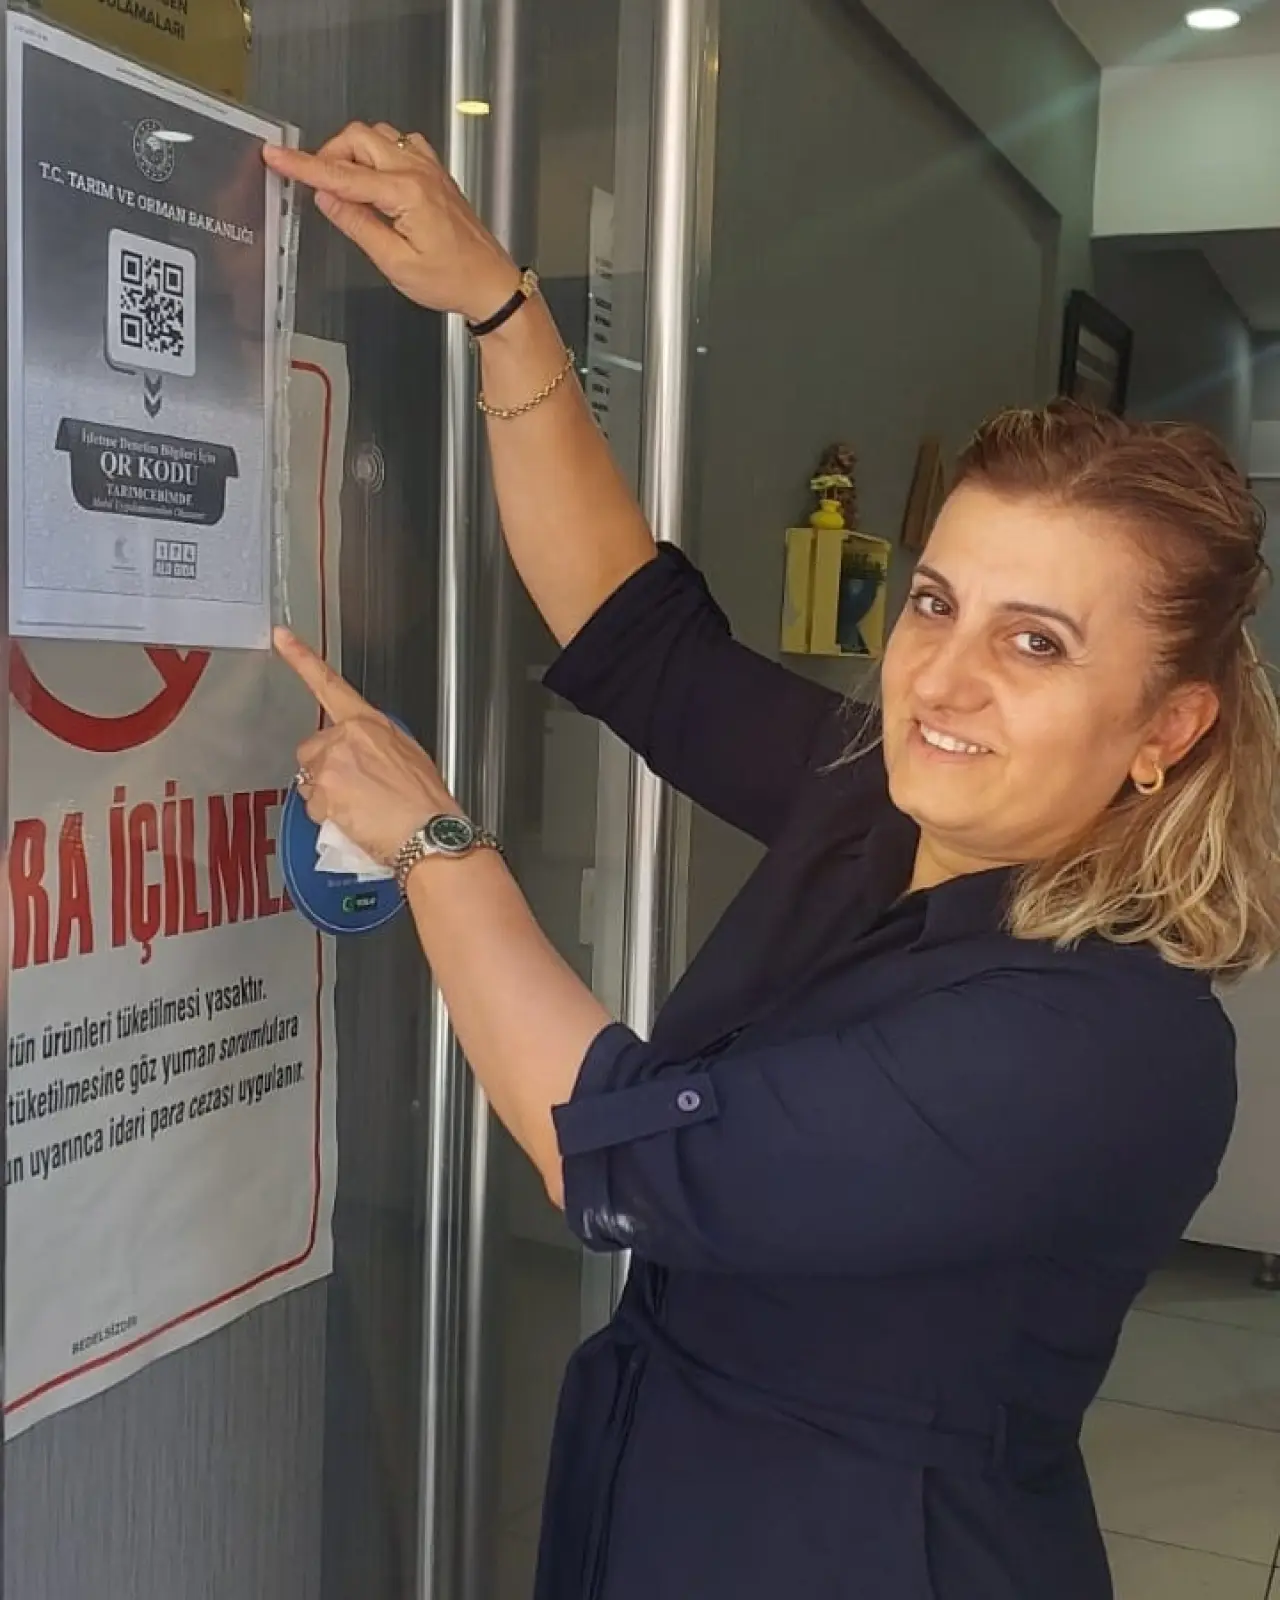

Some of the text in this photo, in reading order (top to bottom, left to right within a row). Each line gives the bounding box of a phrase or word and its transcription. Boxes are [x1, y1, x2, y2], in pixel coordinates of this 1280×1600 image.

[38, 161, 64, 184] T.C.
[67, 170, 115, 200] TARIM
[117, 184, 136, 206] VE
[138, 194, 187, 223] ORMAN
[100, 451, 200, 487] QR KODU
[9, 780, 300, 969] RA İÇİLME
[43, 1011, 111, 1058] ürünleri
[116, 990, 200, 1039] tüketilmesi
[205, 975, 268, 1021] yasaktır.
[9, 1065, 125, 1126] tüketilmesine
[130, 1054, 158, 1094] göz
[161, 1041, 217, 1085] yuman
[30, 1128, 103, 1180] uyarınca
[109, 1107, 146, 1149] idari
[150, 1100, 185, 1141] para
[188, 1083, 235, 1119] cezası
